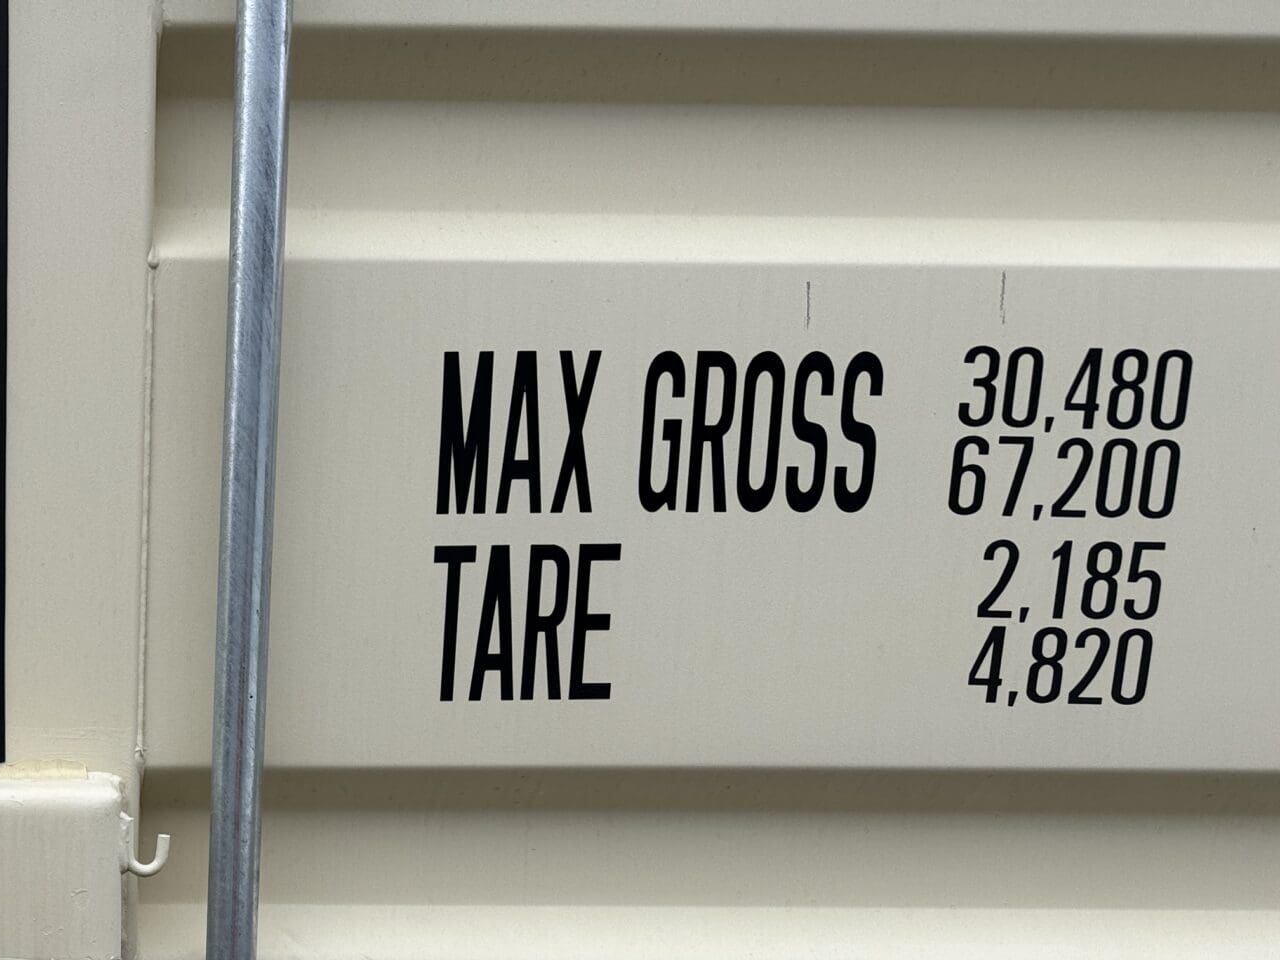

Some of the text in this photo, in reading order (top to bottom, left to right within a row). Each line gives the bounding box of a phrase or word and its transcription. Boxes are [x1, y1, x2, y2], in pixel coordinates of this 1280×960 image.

[435, 345, 1194, 515] MAX GROSS 30,480
[947, 435, 1182, 521] 67,200
[433, 539, 1167, 702] TARE 2,185
[966, 625, 1154, 707] 4,820
